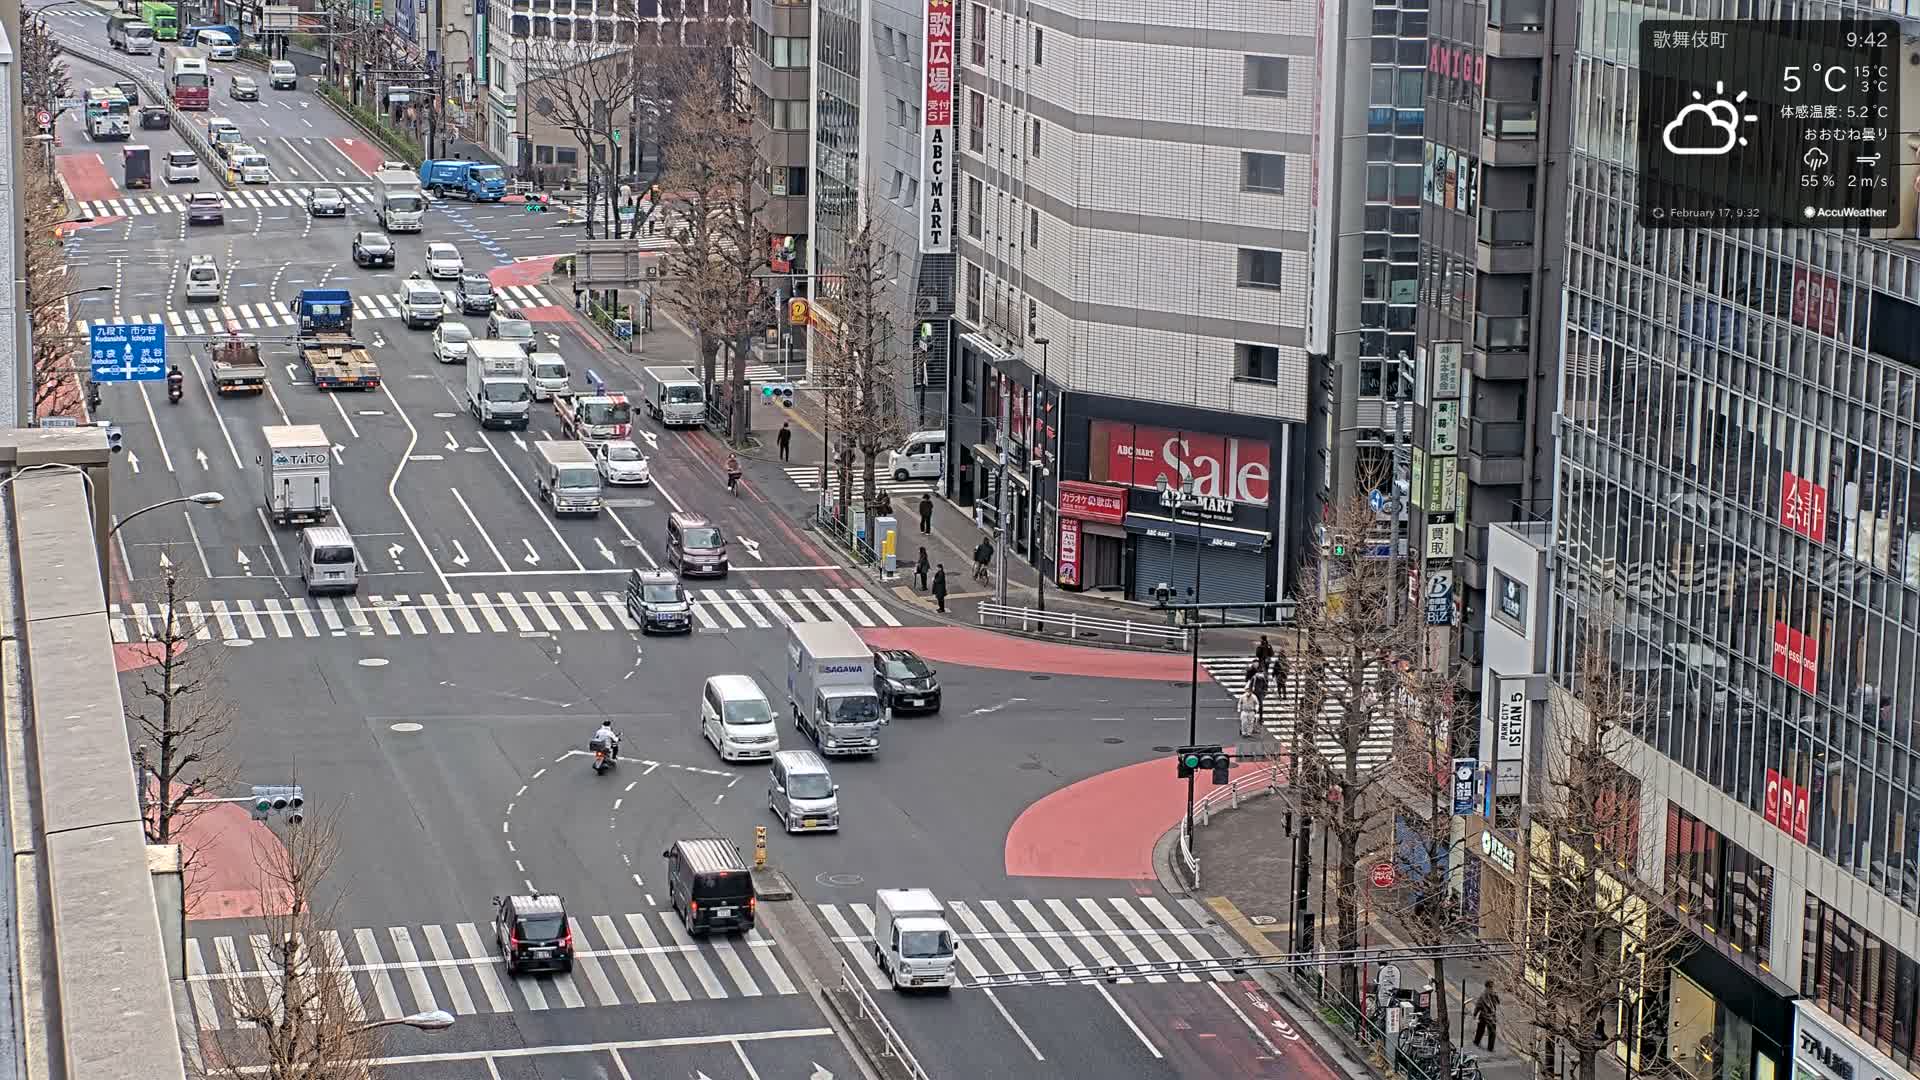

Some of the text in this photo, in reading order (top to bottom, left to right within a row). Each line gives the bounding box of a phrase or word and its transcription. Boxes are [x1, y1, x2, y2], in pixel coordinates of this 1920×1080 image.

[929, 12, 951, 93] 歌広場
[1429, 44, 1484, 86] AMIGO
[928, 100, 949, 111] 受付
[928, 112, 949, 121] 5F
[930, 129, 943, 245] ABC-MART
[97, 326, 125, 336] 九段下
[1117, 445, 1154, 457] ABCMART
[1163, 437, 1269, 503] Sale
[1062, 493, 1088, 504] カラオケ
[1432, 528, 1444, 555] 買取
[826, 665, 863, 673] SAGAWA
[1500, 703, 1509, 741] PARK CITY
[1509, 692, 1523, 747] ISETAN 5
[1767, 780, 1806, 830] CPA
